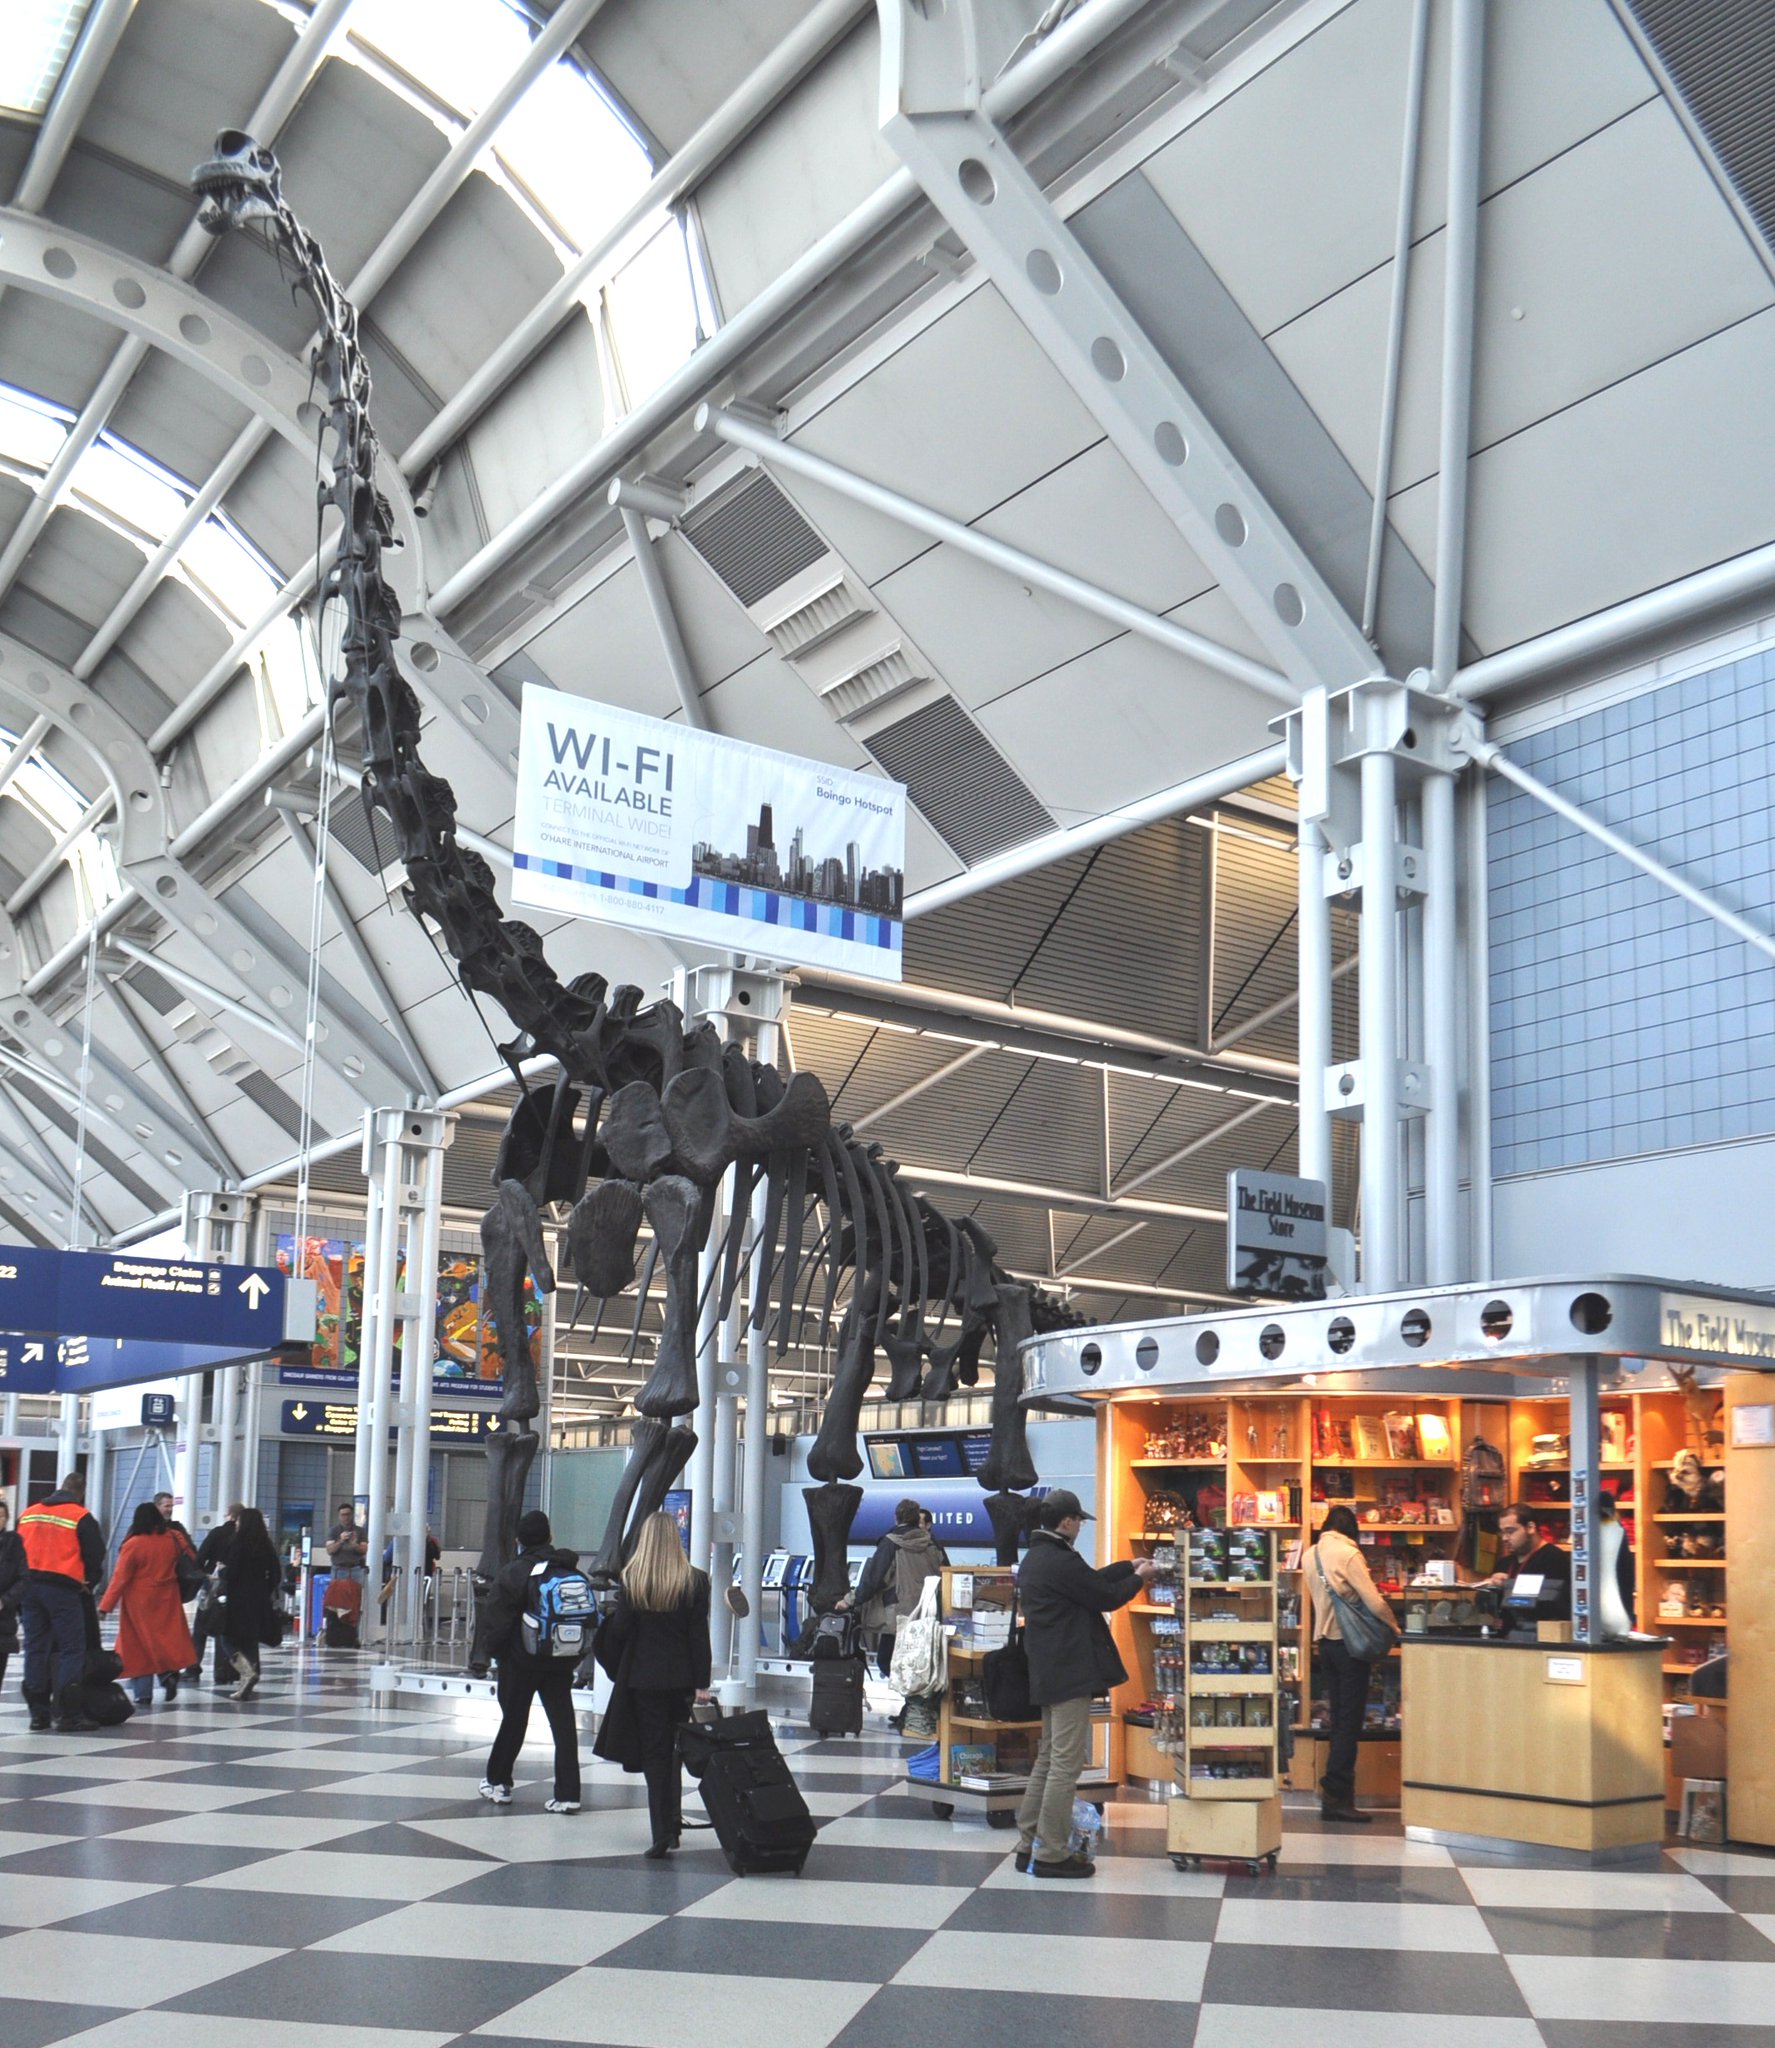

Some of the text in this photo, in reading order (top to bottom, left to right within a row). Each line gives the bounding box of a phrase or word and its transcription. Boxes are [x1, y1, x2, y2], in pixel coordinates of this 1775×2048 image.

[547, 722, 673, 792] WI-FI
[543, 769, 672, 818] AVAILABLE
[816, 775, 834, 786] SSID
[542, 795, 624, 829] TERMINAL
[816, 786, 893, 816] Boingo Hotspot
[540, 832, 670, 868] O'HARE INTERNATIONAL AIRPORT
[1237, 1186, 1324, 1221] The Field Museum
[1268, 1213, 1294, 1238] Store
[113, 1261, 204, 1279] Baggage Claim
[1667, 1309, 1692, 1348] The
[1697, 1313, 1729, 1352] Field
[931, 1512, 973, 1524] NITED
